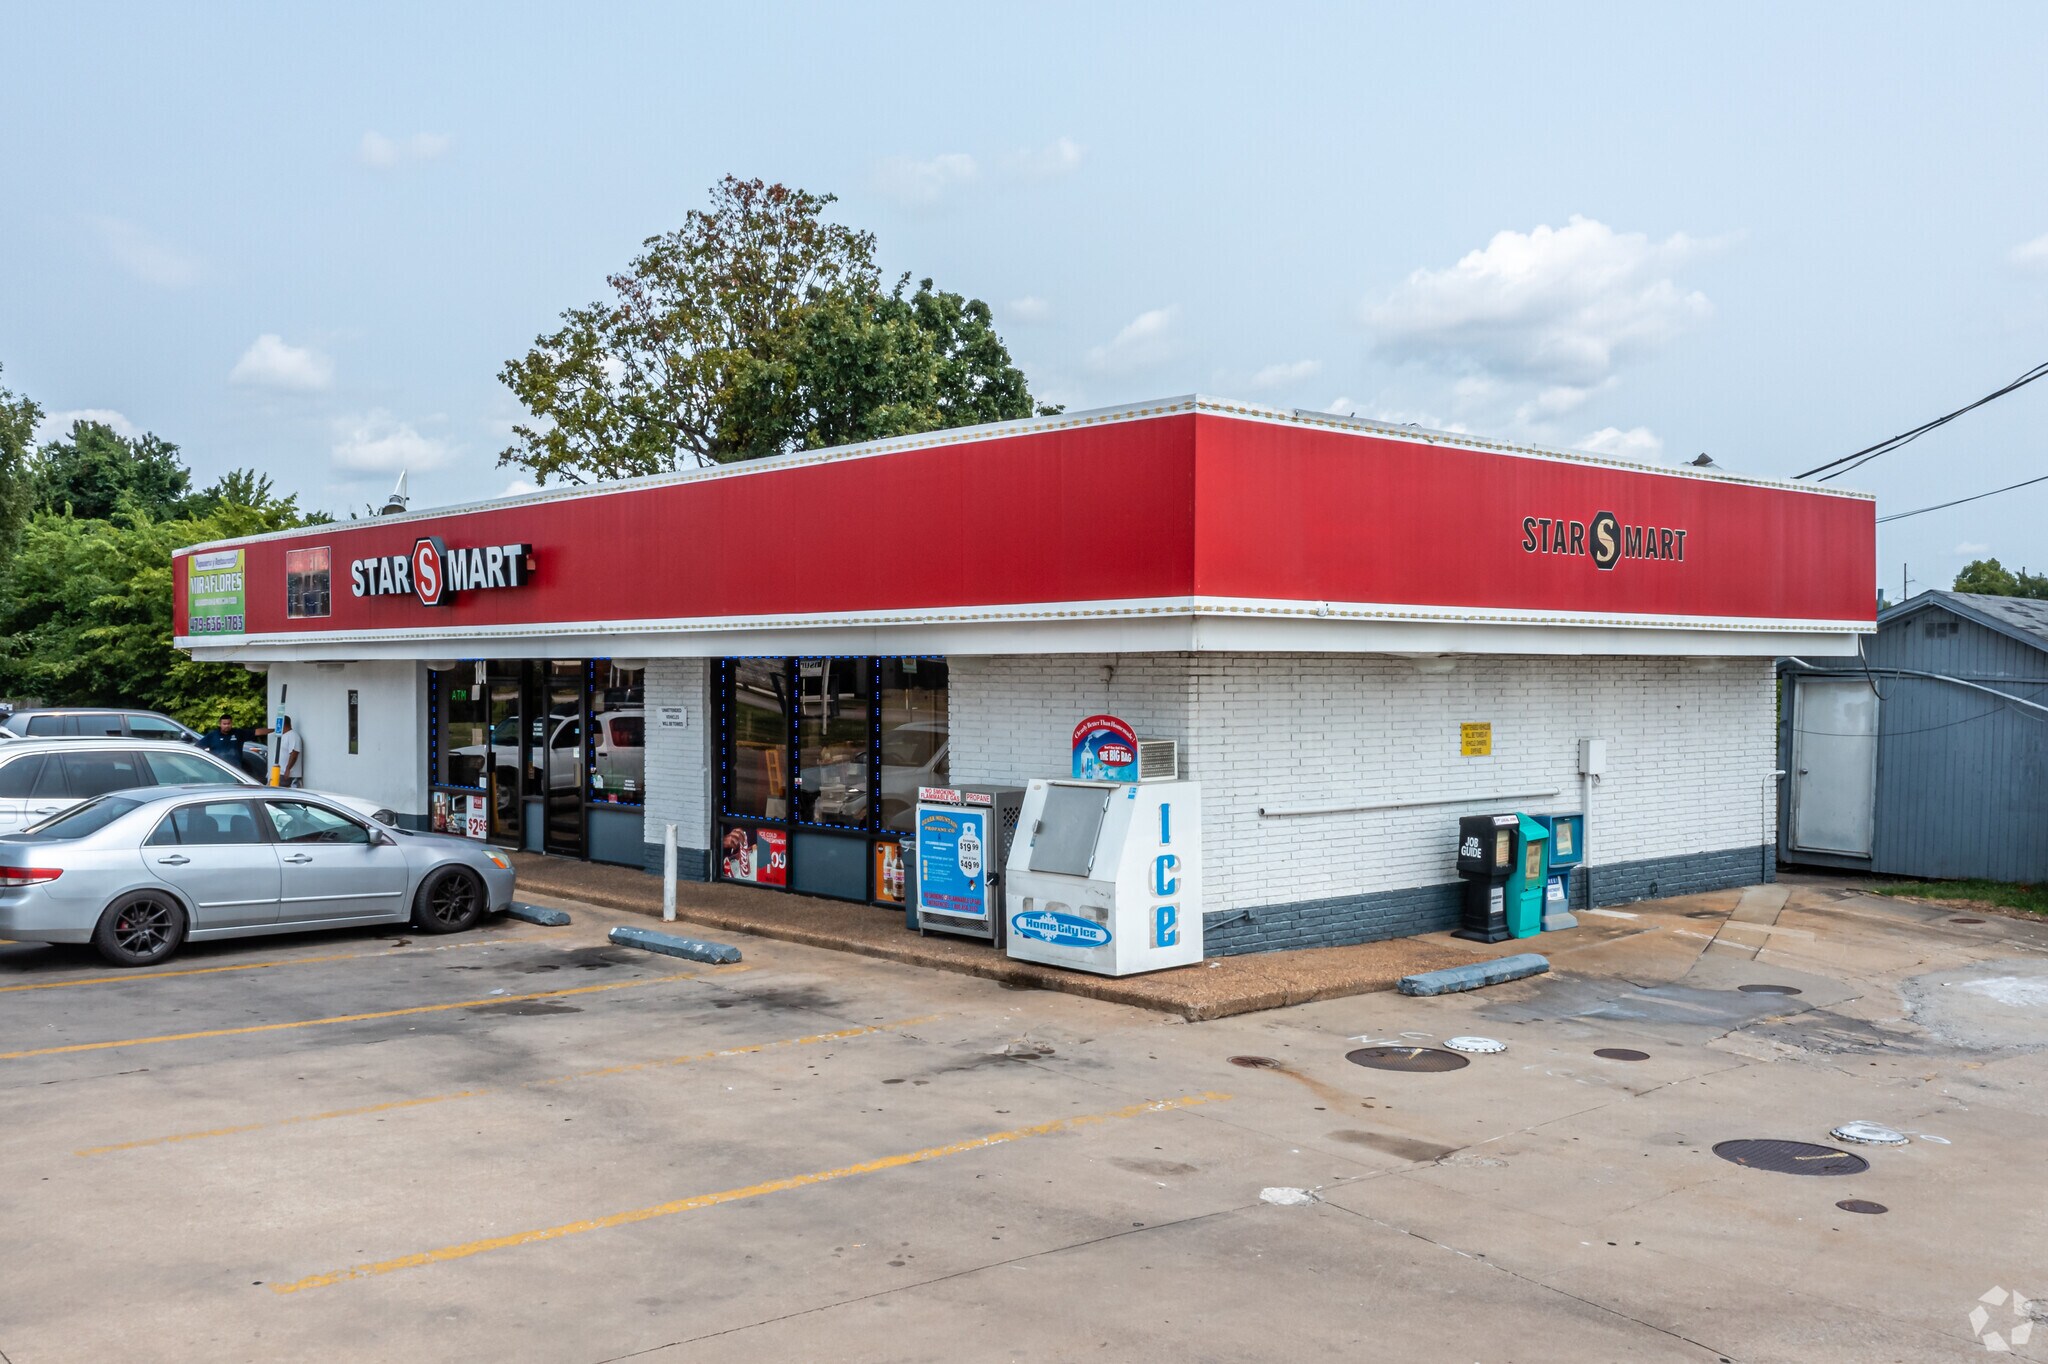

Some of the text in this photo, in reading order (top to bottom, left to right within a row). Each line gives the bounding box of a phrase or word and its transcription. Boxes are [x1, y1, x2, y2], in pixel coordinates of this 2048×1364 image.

[1522, 516, 1586, 556] STAR
[1624, 525, 1688, 562] MART
[351, 555, 411, 597] STAR
[447, 544, 522, 591] MART
[190, 572, 243, 594] MIRAFLORES
[452, 690, 467, 700] ATM
[1099, 749, 1132, 763] THE BIG BAG
[920, 792, 949, 800] FLAMMABLE
[966, 793, 990, 802] PROPANE
[1465, 836, 1479, 847] JOB
[1461, 845, 1482, 858] GUIDE
[1026, 918, 1096, 938] Home City Ice
